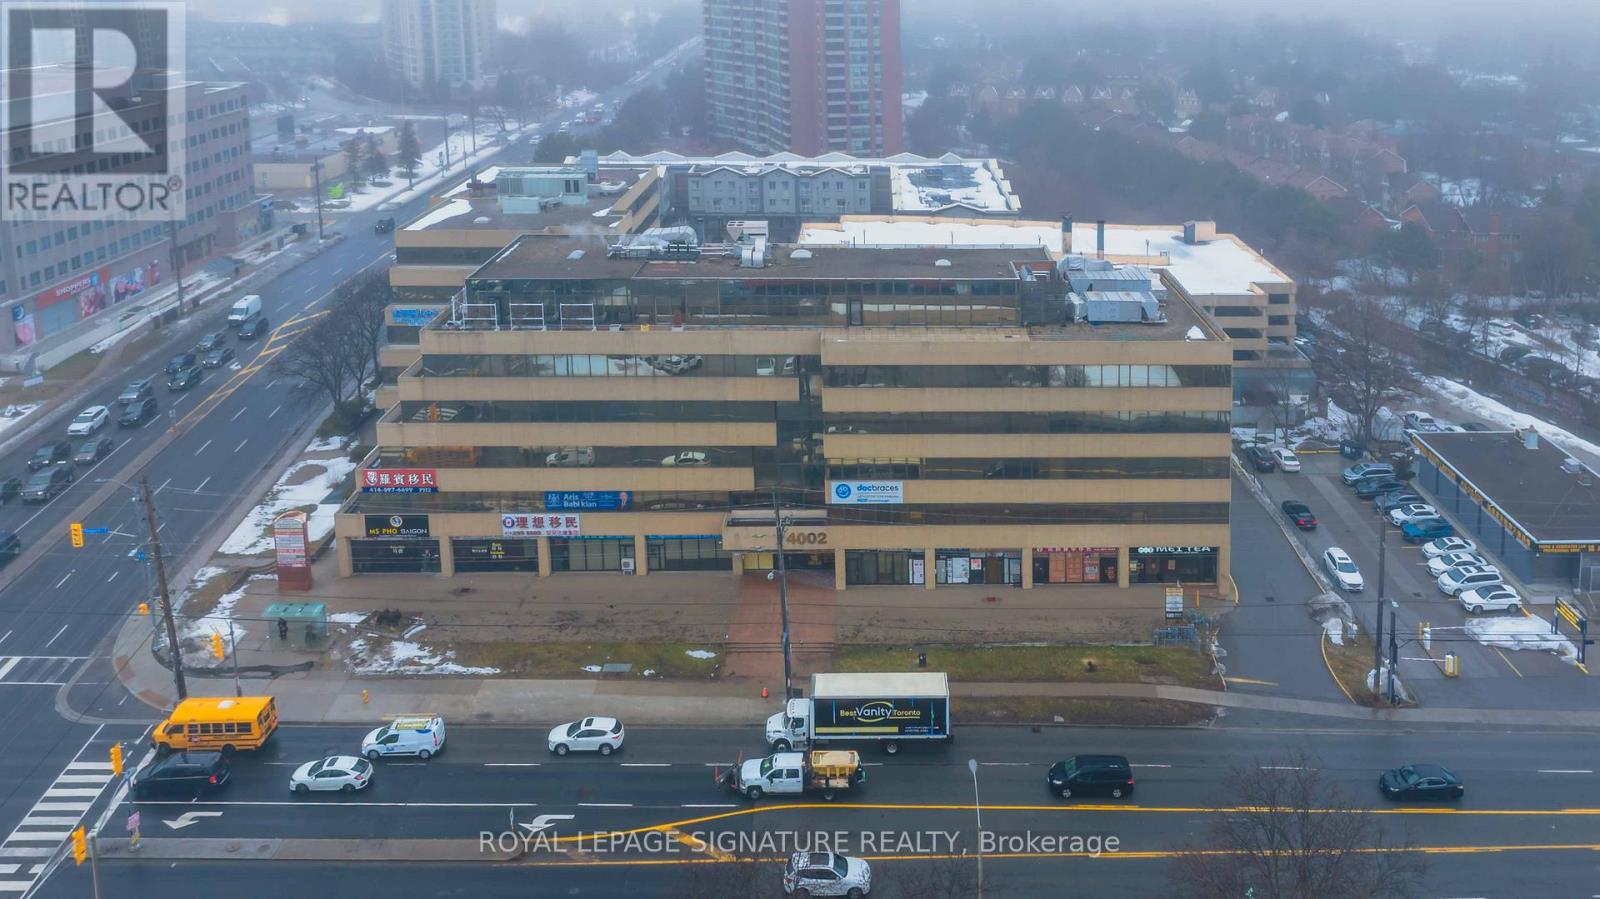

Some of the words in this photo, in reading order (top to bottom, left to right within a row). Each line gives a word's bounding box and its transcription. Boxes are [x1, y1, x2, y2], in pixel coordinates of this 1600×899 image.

[857, 484, 899, 492] docbraces
[515, 516, 578, 528] 理想移民
[786, 532, 828, 545] 4002
[839, 709, 856, 717] Best
[856, 706, 892, 719] Vanity
